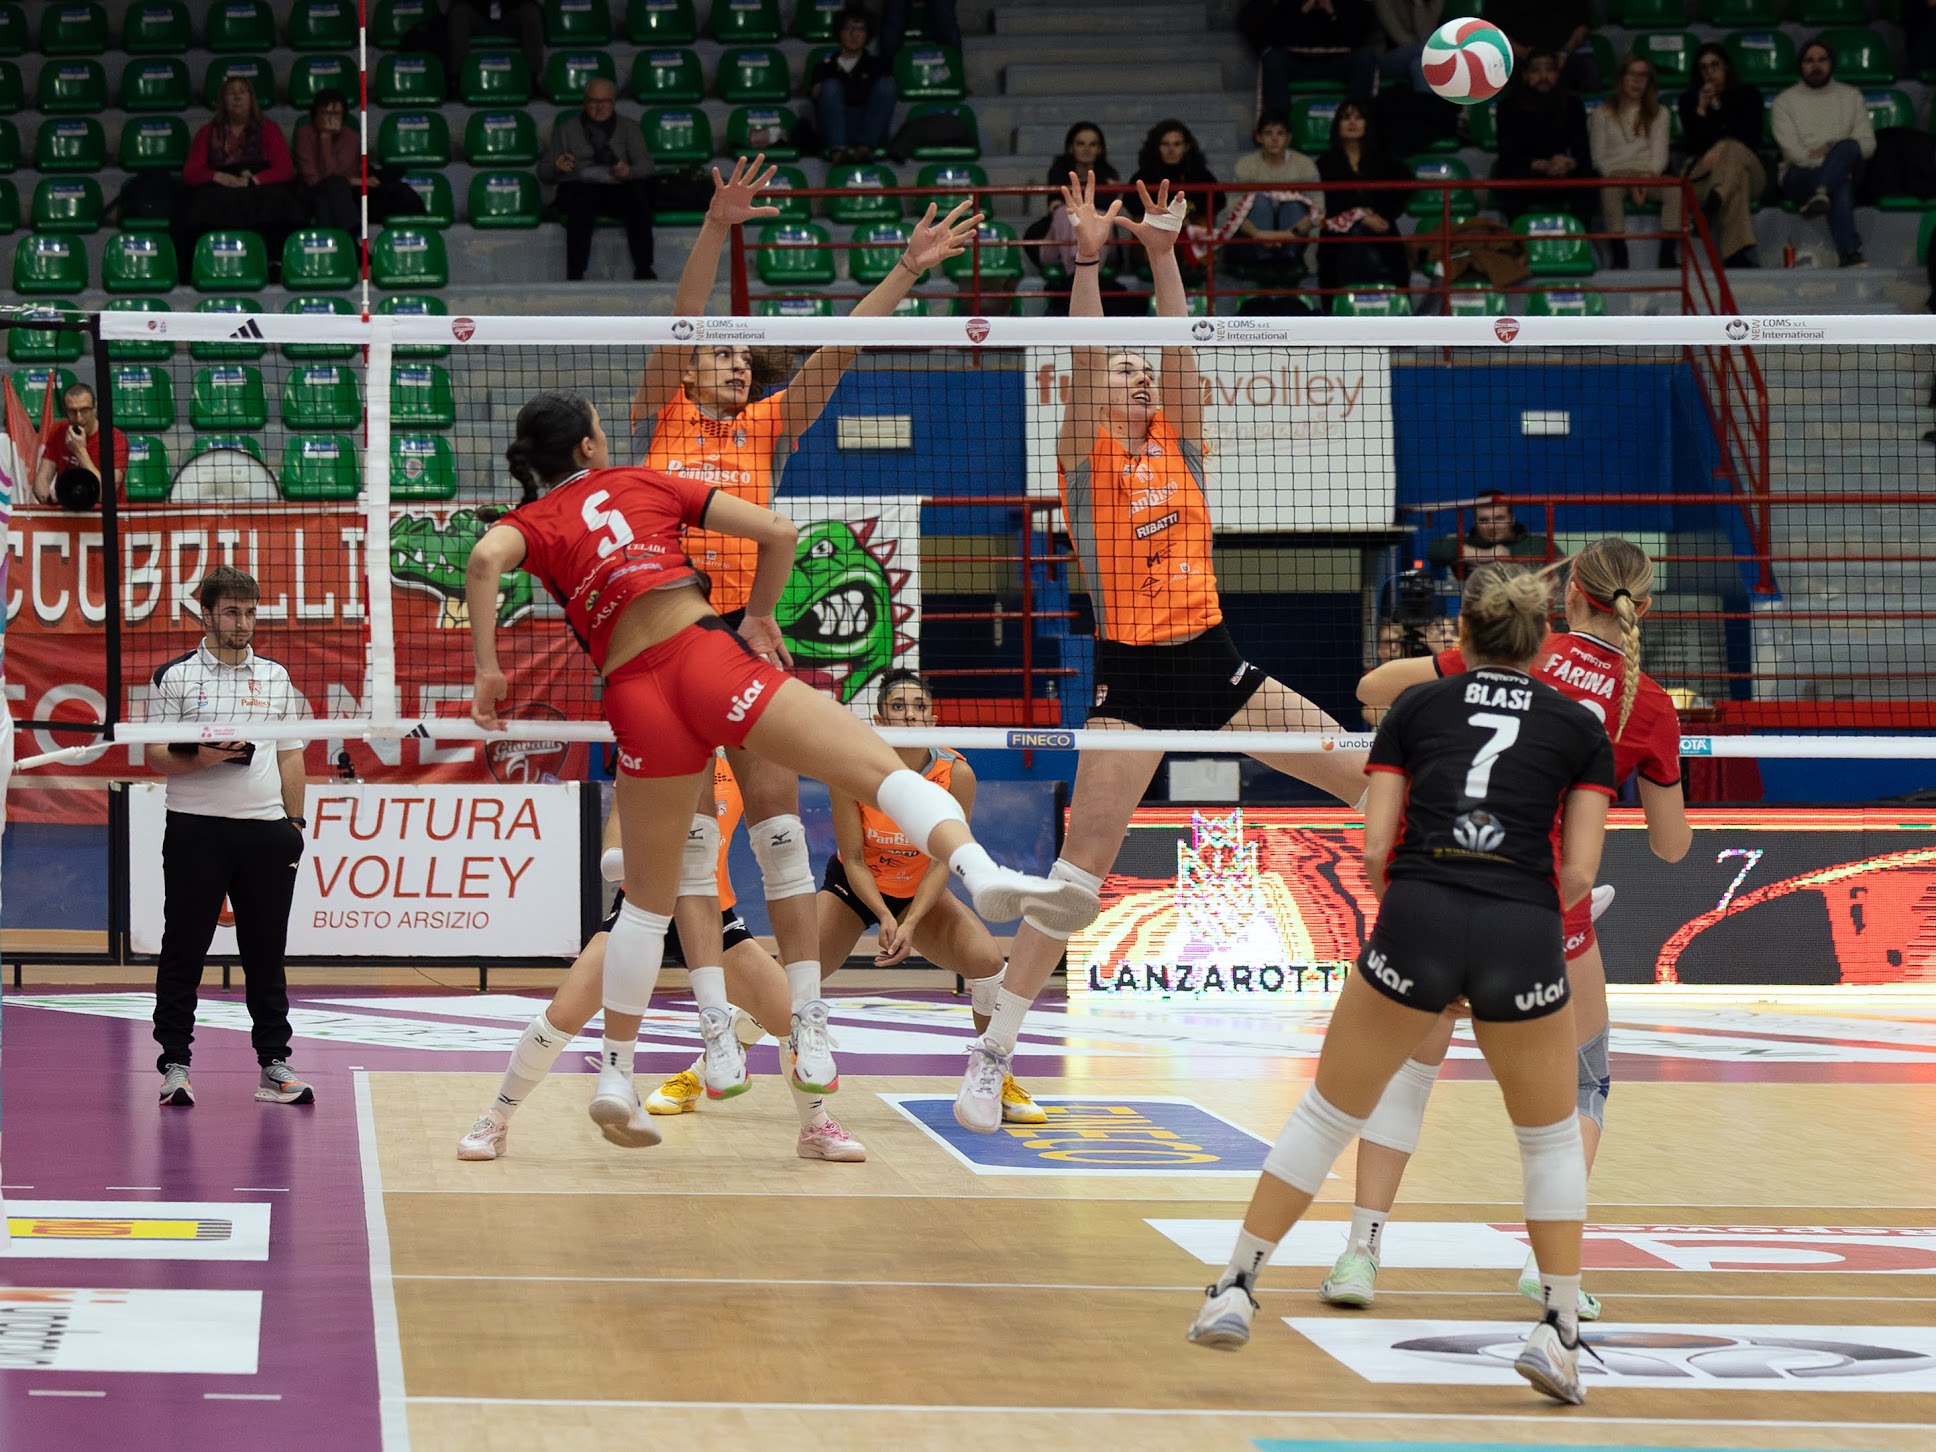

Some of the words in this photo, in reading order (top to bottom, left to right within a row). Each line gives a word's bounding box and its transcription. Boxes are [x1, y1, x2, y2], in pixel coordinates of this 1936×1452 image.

[696, 320, 704, 341] NEW
[707, 320, 734, 328] COMS
[1217, 320, 1225, 341] NEW
[1228, 320, 1256, 328] COMS
[1752, 319, 1760, 341] NEW
[1762, 331, 1825, 339] International
[1763, 319, 1792, 327] COMS
[1227, 332, 1288, 340] International
[581, 489, 634, 559] 5
[1137, 512, 1178, 538] RIBATTI
[1543, 654, 1616, 699] FARINA
[726, 679, 766, 722] viar
[1465, 682, 1533, 711] BLASI
[1012, 734, 1070, 746] FINECO
[1464, 712, 1520, 798] 7
[313, 798, 541, 841] FUTURA
[313, 855, 535, 899] VOLLEY
[313, 911, 391, 929] BUSTO
[397, 911, 490, 929] ARSIZIO
[1367, 950, 1414, 996] viar
[1514, 977, 1566, 1012] viar
